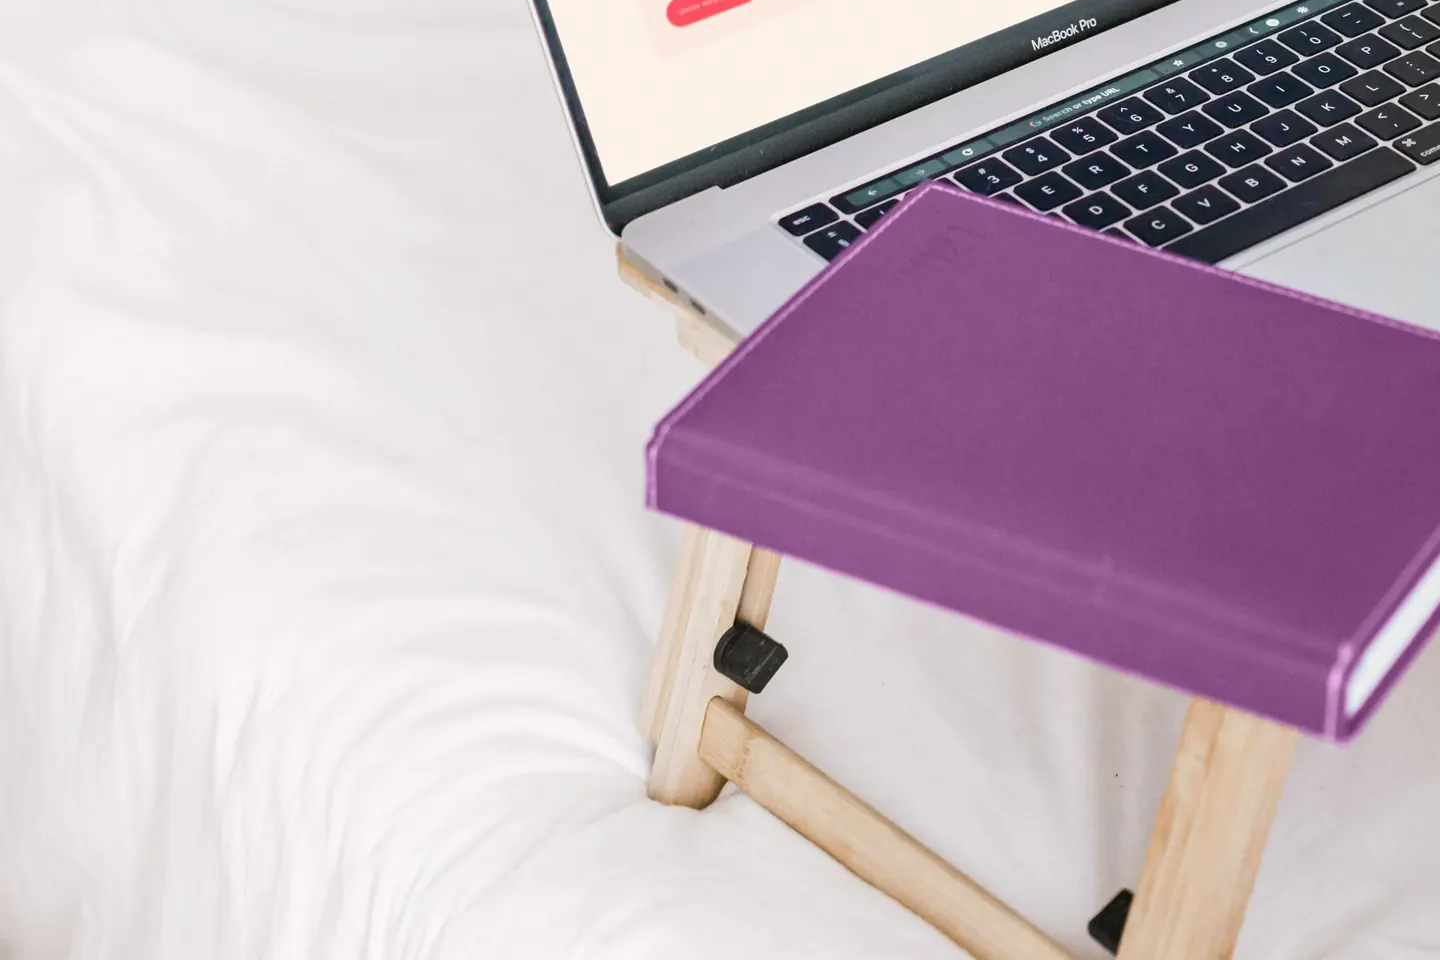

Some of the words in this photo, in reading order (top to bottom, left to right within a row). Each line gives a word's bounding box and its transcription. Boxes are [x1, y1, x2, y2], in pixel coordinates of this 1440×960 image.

[1031, 23, 1079, 51] MacBook
[1078, 17, 1097, 32] Pro
[1309, 36, 1321, 44] 0
[1360, 46, 1371, 55] P
[1265, 55, 1277, 64] 9
[1318, 65, 1331, 73] O
[1221, 74, 1233, 83] 8
[1365, 84, 1379, 92] L
[1175, 94, 1185, 102] 7
[1042, 107, 1073, 121] Search
[1073, 102, 1082, 110] or
[1082, 94, 1102, 105] type
[1100, 87, 1120, 97] URL
[1227, 103, 1242, 113] U
[1320, 102, 1336, 112] K
[1130, 114, 1142, 122] 6
[1182, 123, 1195, 132] Y
[1280, 122, 1290, 131] J
[1083, 134, 1096, 142] 5
[1335, 135, 1352, 147] M
[1136, 143, 1149, 153] T
[1230, 142, 1246, 152] H
[1037, 154, 1048, 163] 4
[1290, 156, 1307, 166] N
[1088, 165, 1103, 174] R
[1184, 163, 1199, 173] G
[987, 175, 1000, 184] 3
[1244, 178, 1259, 188] B
[1041, 185, 1055, 195] E
[1137, 183, 1149, 193] F
[1197, 198, 1211, 208] V
[1088, 205, 1103, 215] D
[1151, 220, 1166, 230] C
